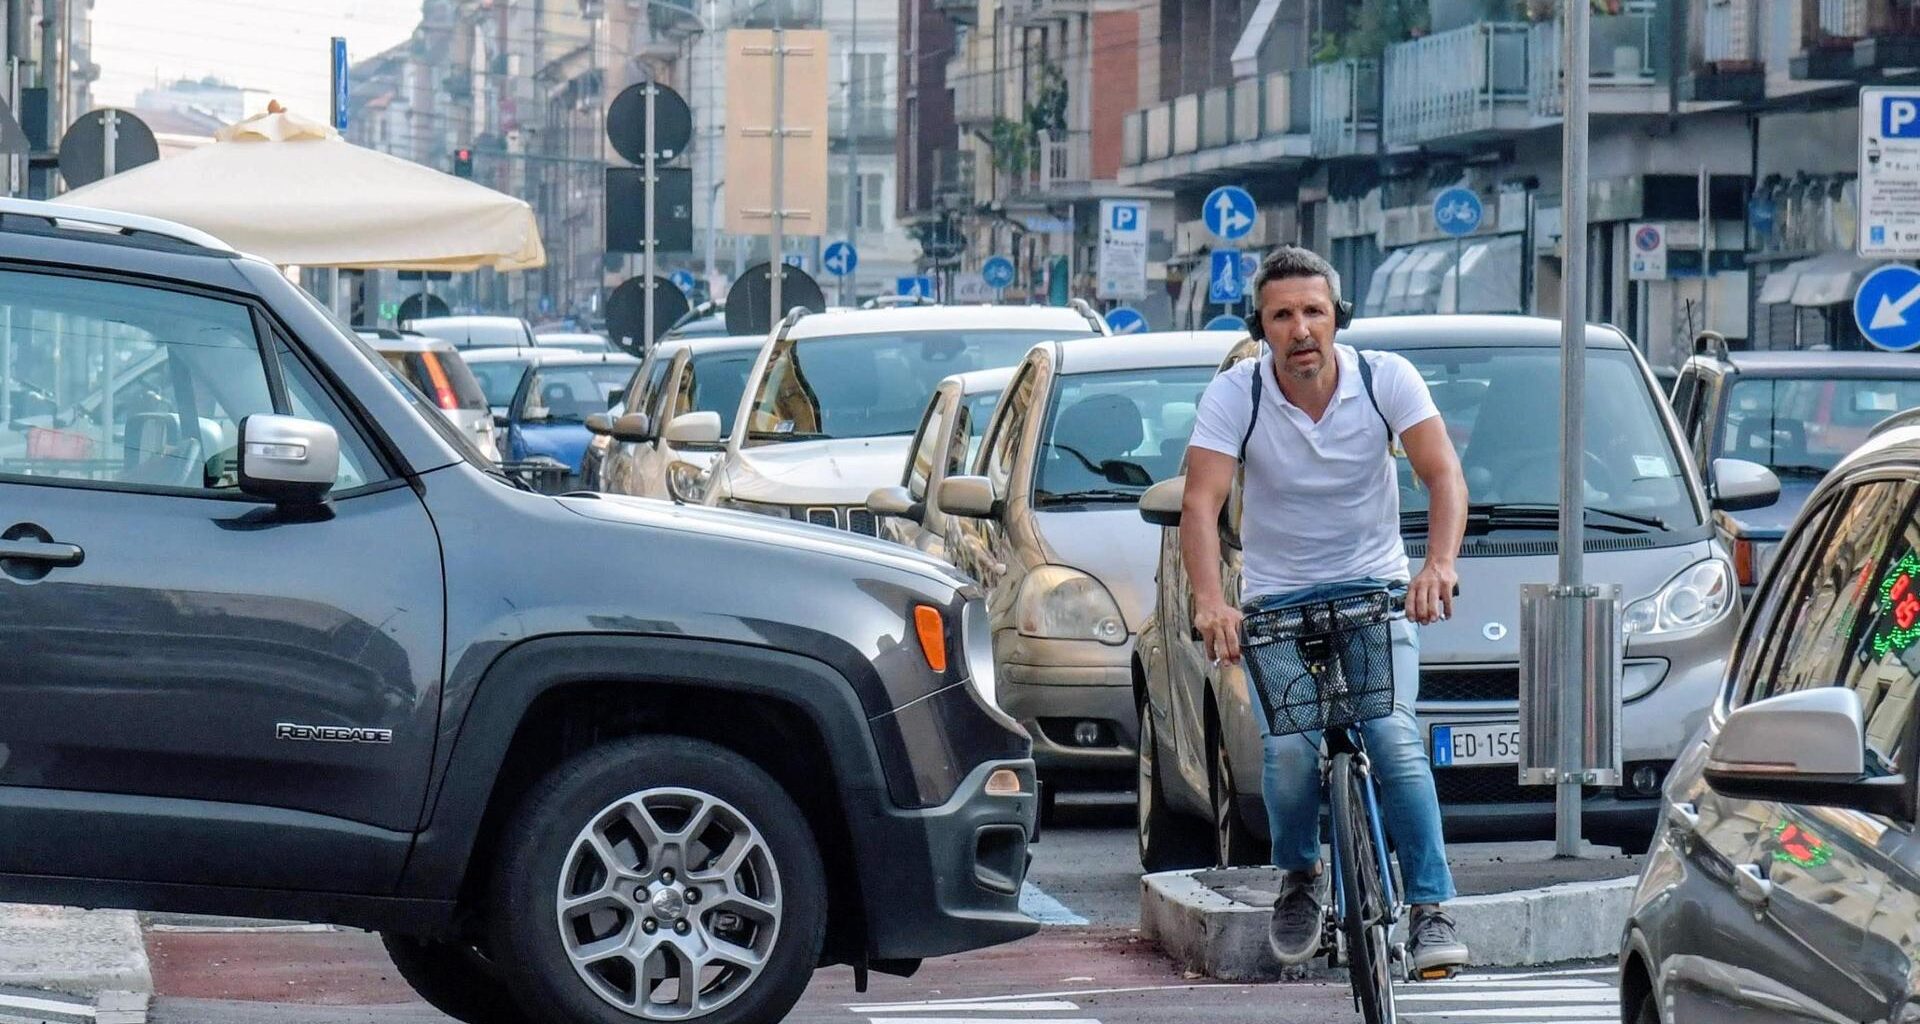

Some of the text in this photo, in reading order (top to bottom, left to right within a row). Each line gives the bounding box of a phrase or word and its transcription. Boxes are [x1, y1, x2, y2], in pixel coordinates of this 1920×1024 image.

[1889, 101, 1917, 134] P
[1117, 208, 1133, 228] P
[276, 723, 393, 743] RENEGADE
